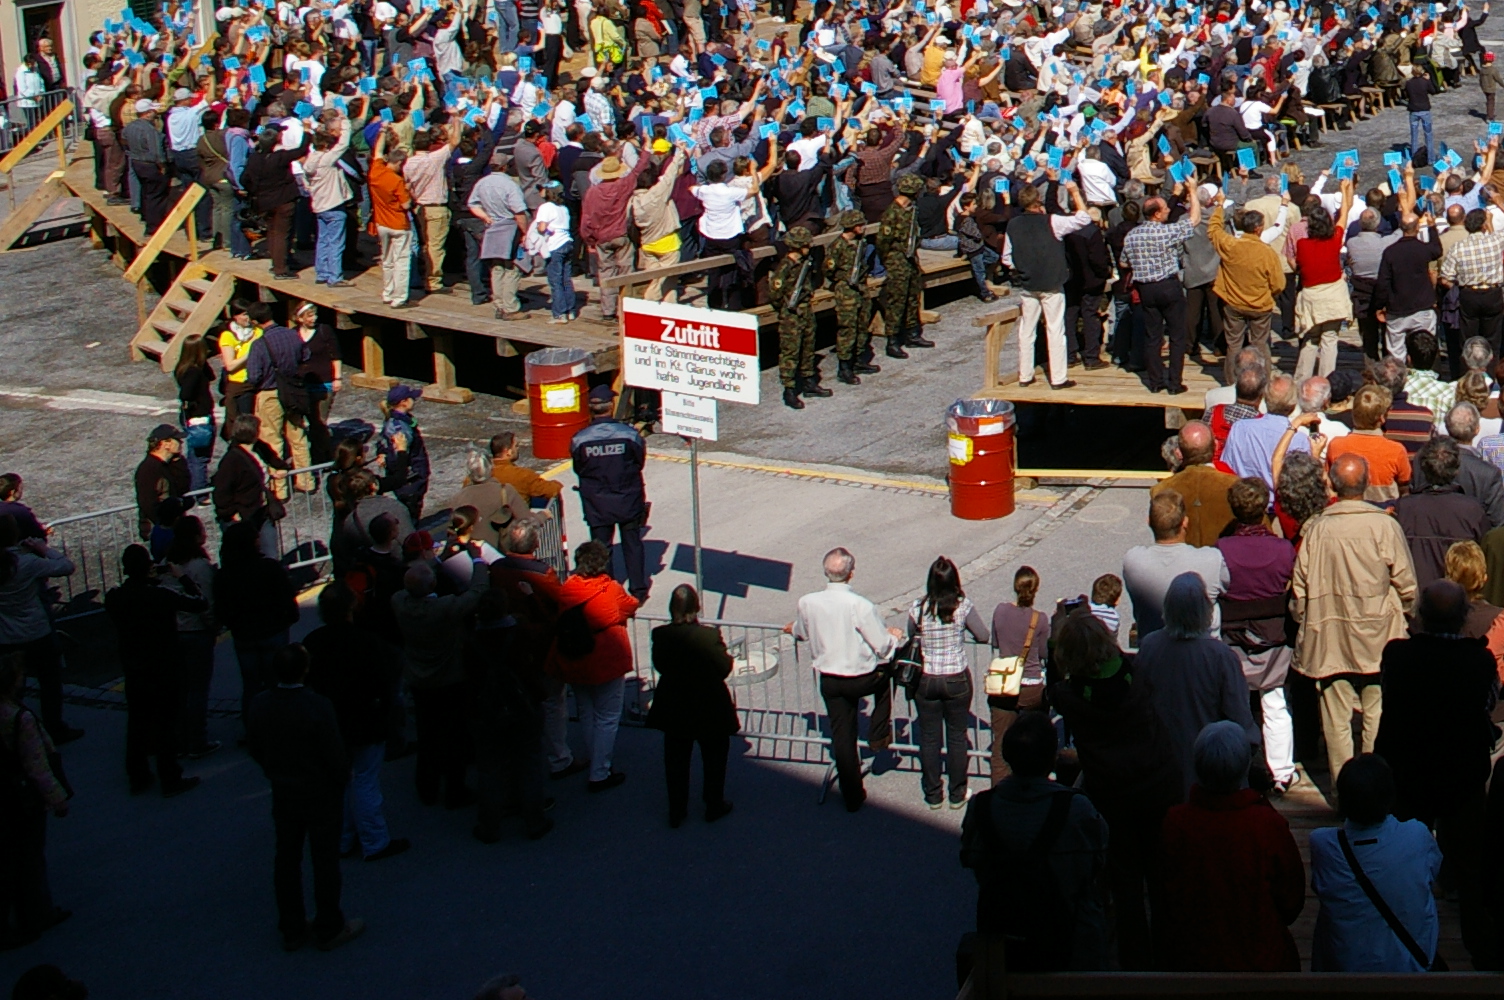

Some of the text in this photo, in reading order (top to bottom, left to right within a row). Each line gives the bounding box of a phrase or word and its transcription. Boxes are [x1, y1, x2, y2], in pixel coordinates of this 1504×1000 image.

[661, 319, 720, 348] Zutritt
[634, 343, 746, 370] nur für Stimmberechtigte
[635, 356, 748, 381] und im Kt. Glarus wohn-
[656, 369, 741, 393] hafte Jugendliche
[585, 443, 626, 457] POLIZEI
